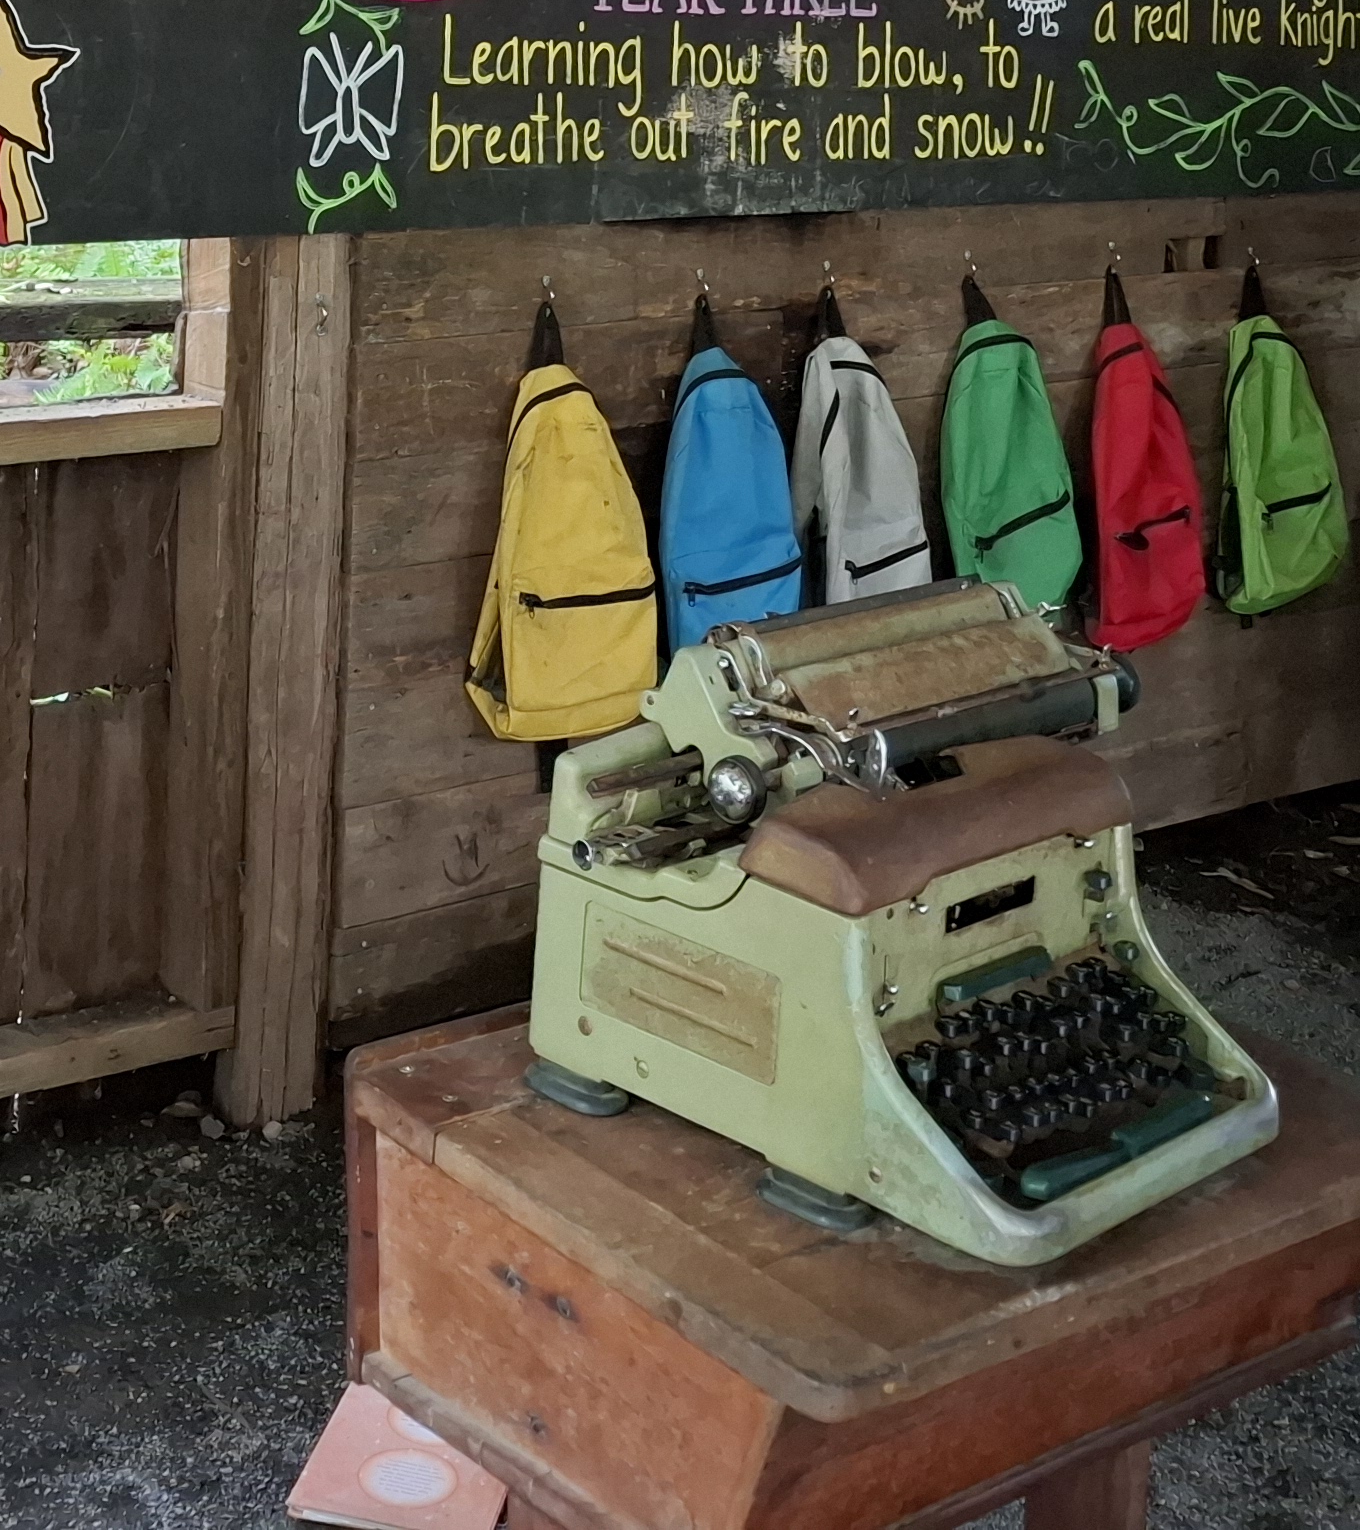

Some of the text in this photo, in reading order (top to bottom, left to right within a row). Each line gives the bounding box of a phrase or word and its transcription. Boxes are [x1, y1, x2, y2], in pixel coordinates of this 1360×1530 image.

[1094, 1, 1116, 44] a
[443, 14, 1020, 117] Learning how to blow, to
[430, 94, 604, 172] breathe
[630, 93, 694, 162] out
[724, 92, 801, 166] fire
[825, 95, 890, 162] and
